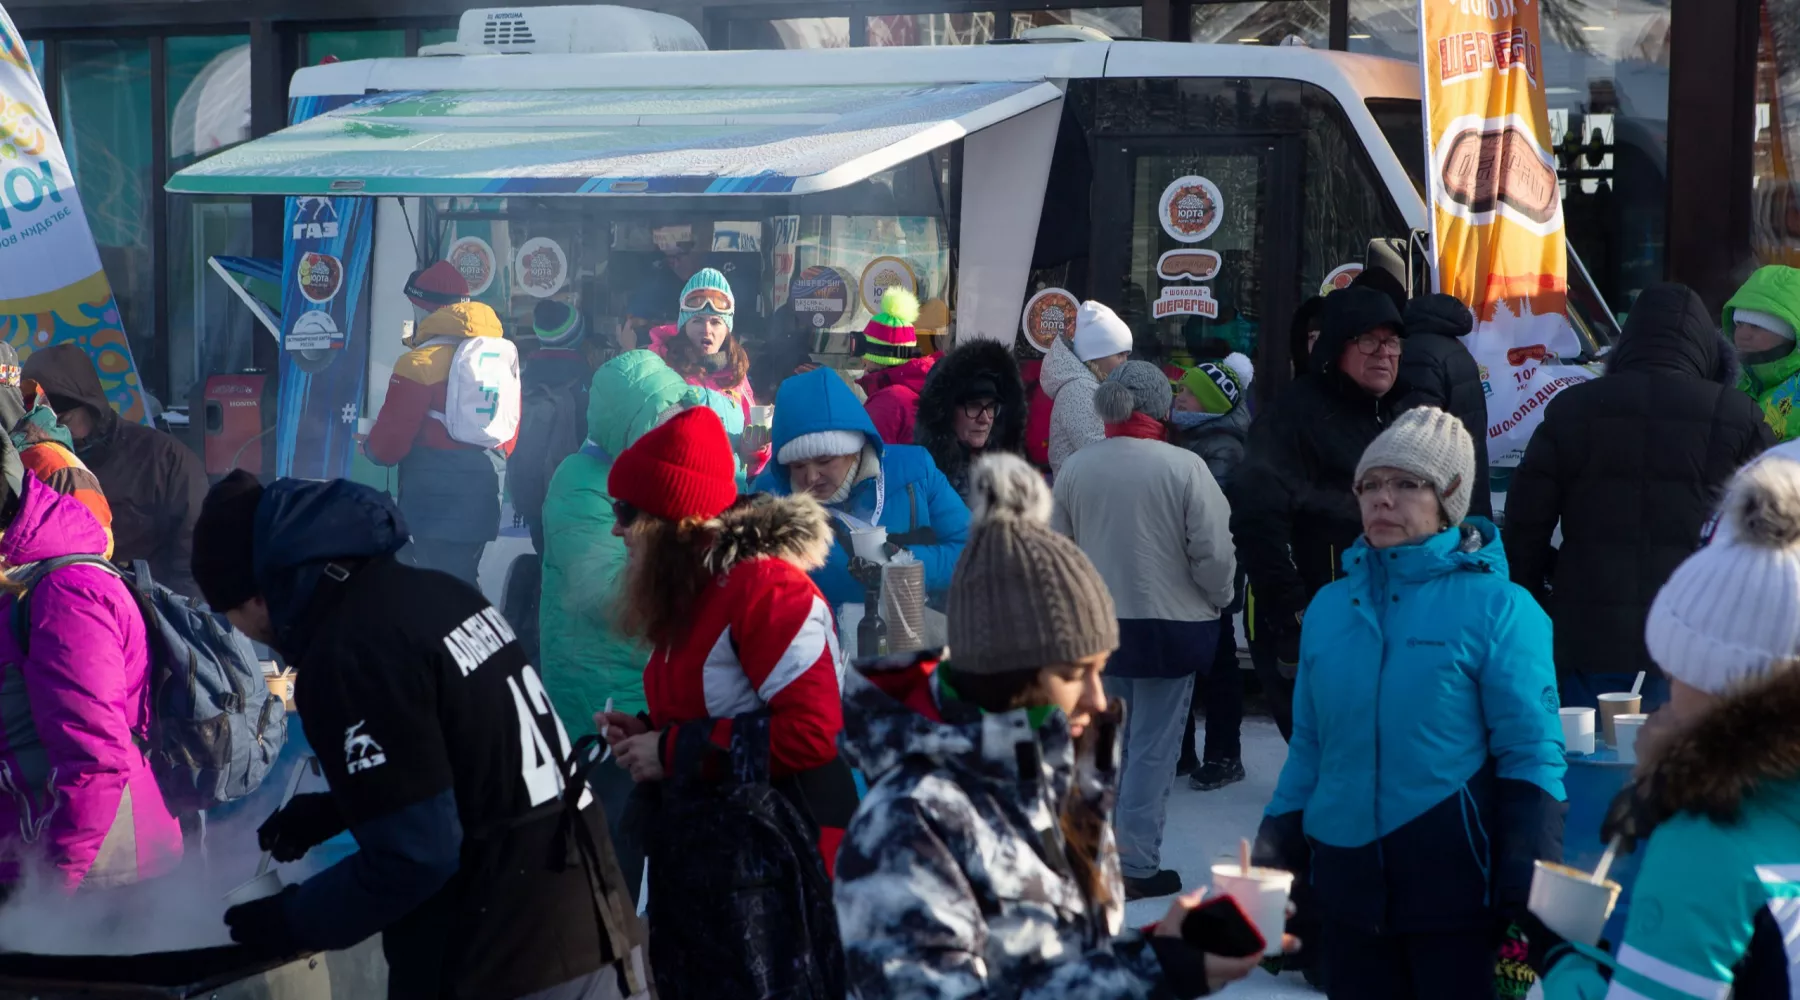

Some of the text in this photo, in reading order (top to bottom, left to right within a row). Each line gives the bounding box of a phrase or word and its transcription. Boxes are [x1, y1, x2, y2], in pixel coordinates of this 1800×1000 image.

[1178, 209, 1204, 219] юрта
[292, 222, 339, 240] ГАЗ
[1169, 289, 1203, 297] ШОКОЛАД
[1156, 298, 1215, 316] ШЕРЕГЕШ
[1040, 320, 1065, 330] юрта
[475, 351, 501, 422] LFT
[229, 400, 258, 408] HONDA
[506, 664, 594, 811] 42
[347, 752, 387, 775] ГАЗ
